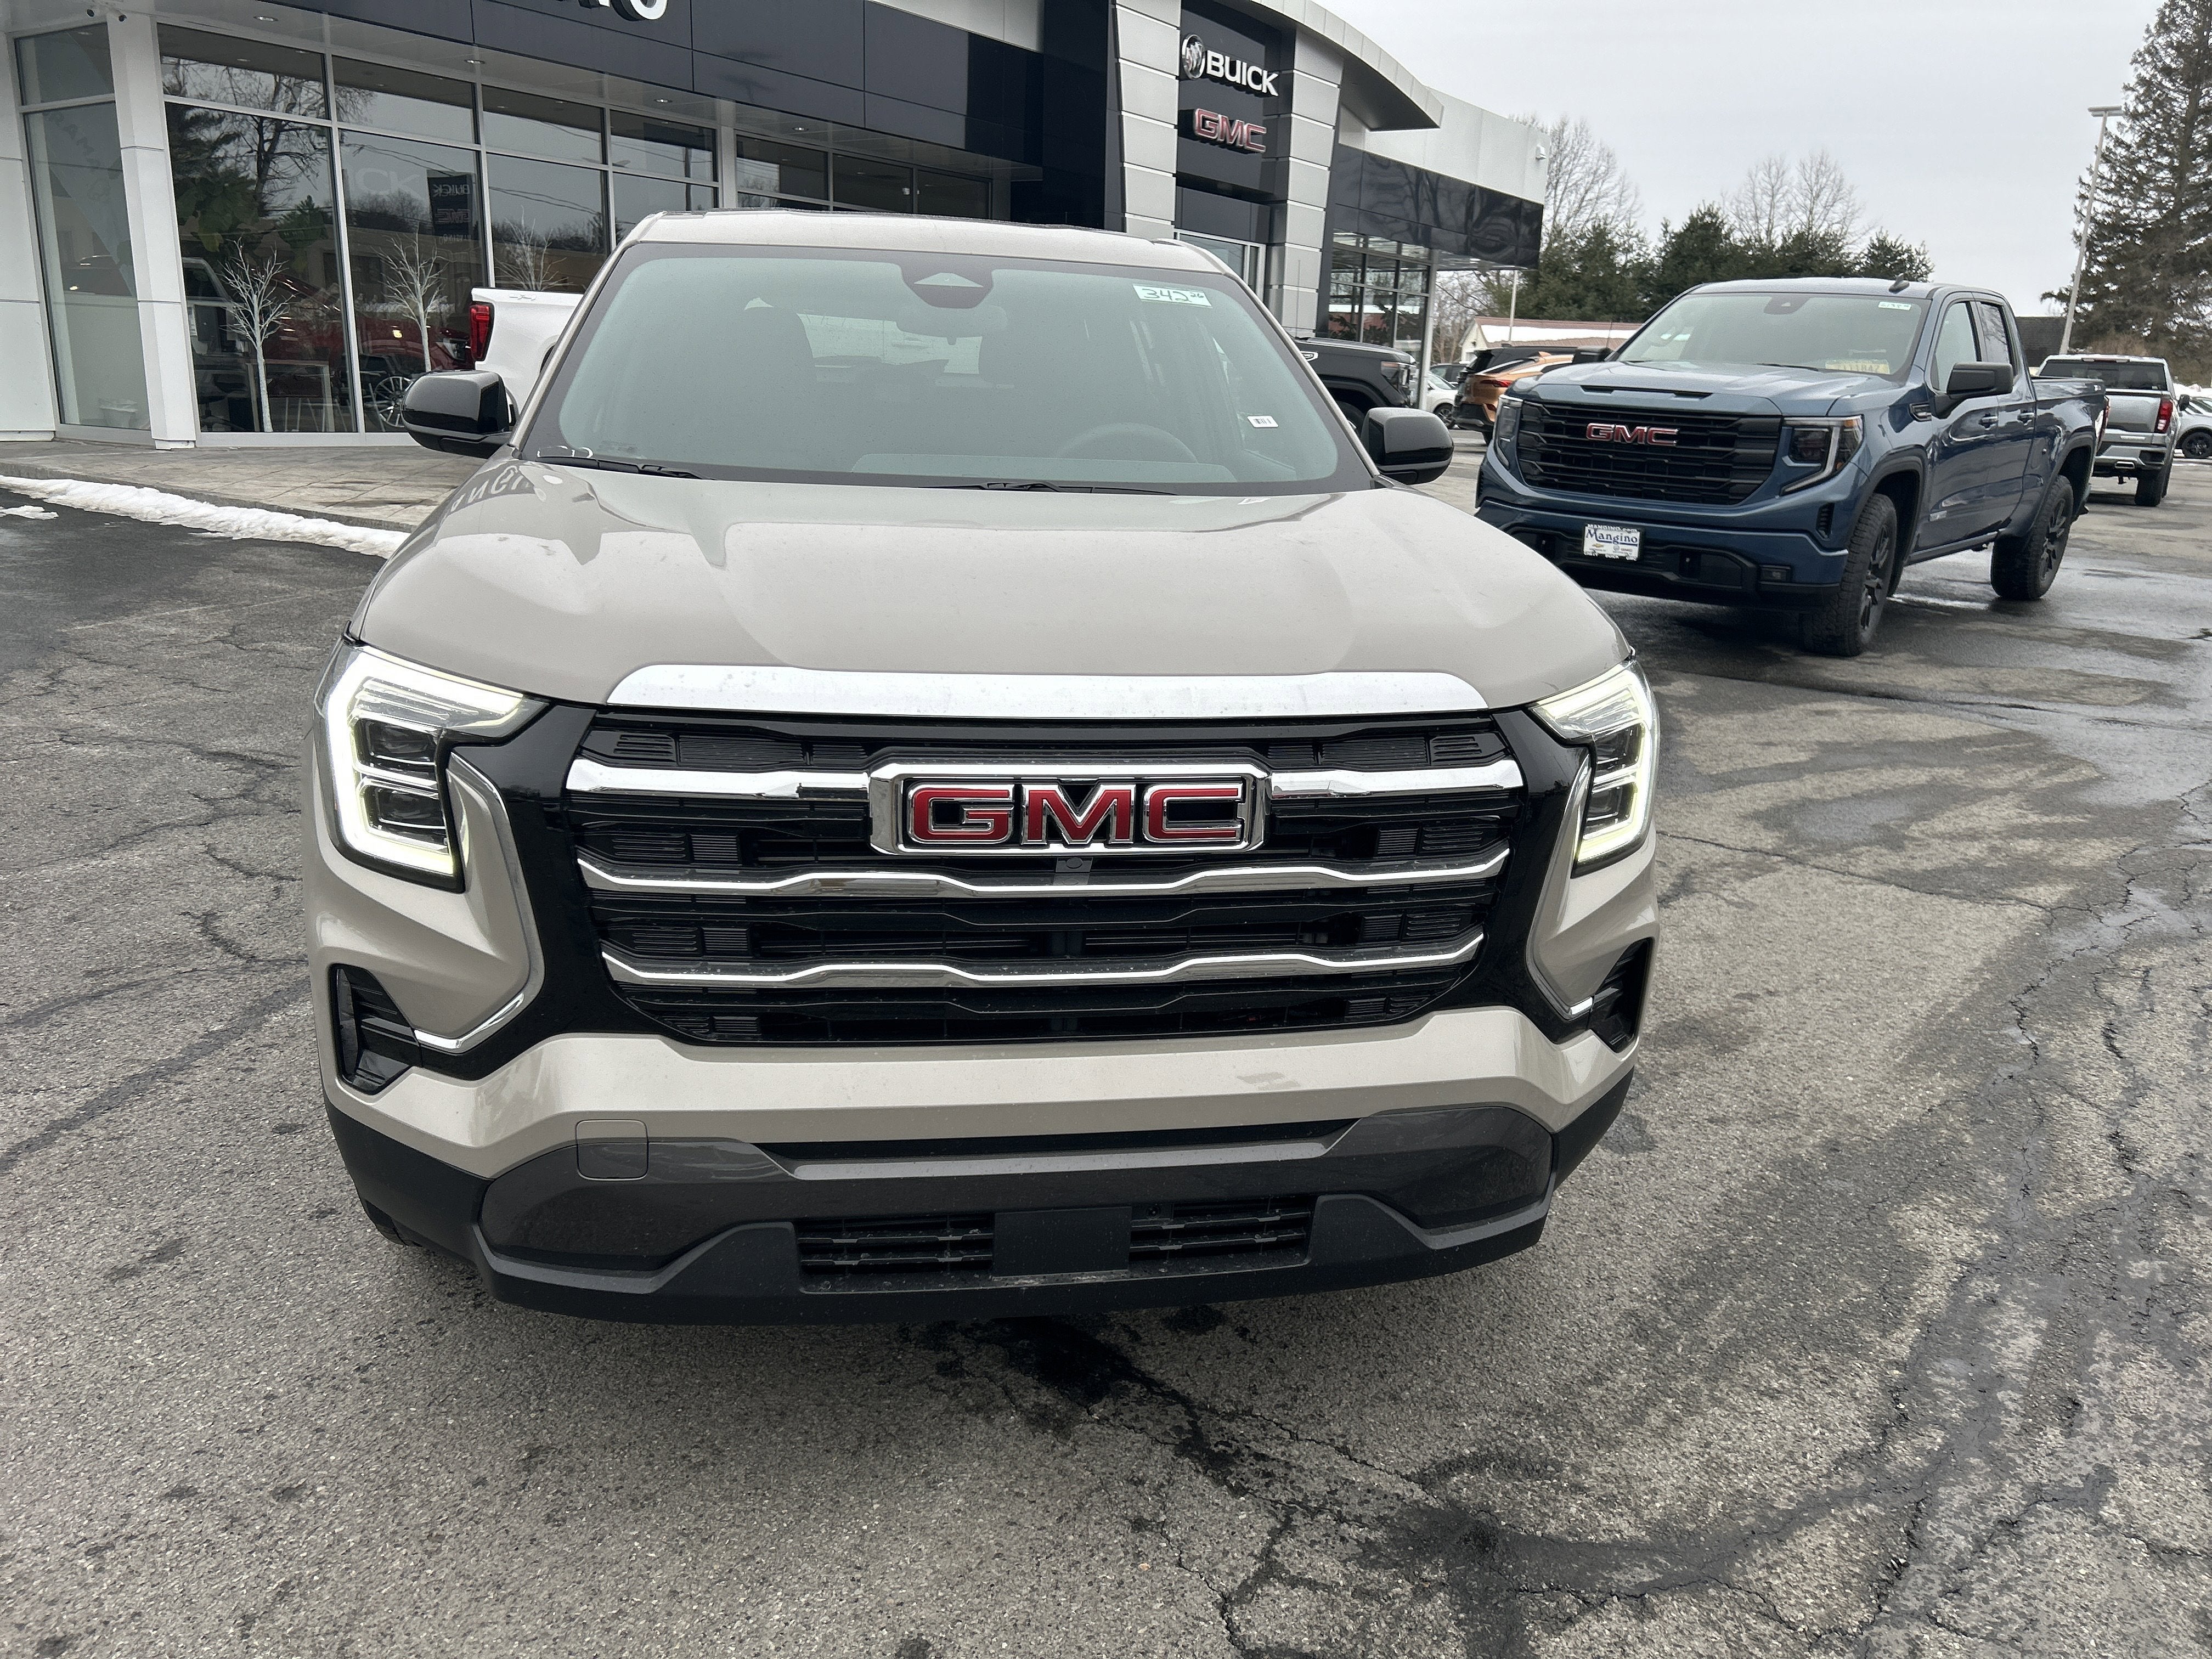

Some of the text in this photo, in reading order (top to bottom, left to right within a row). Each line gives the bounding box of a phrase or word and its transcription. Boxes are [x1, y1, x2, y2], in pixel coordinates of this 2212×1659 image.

[1207, 50, 1279, 97] BUICK
[1195, 108, 1267, 153] GMC
[1142, 288, 1192, 302] 342
[1586, 422, 1680, 447] GMC
[1585, 528, 1638, 545] Mangino
[908, 782, 1243, 845] GMC
